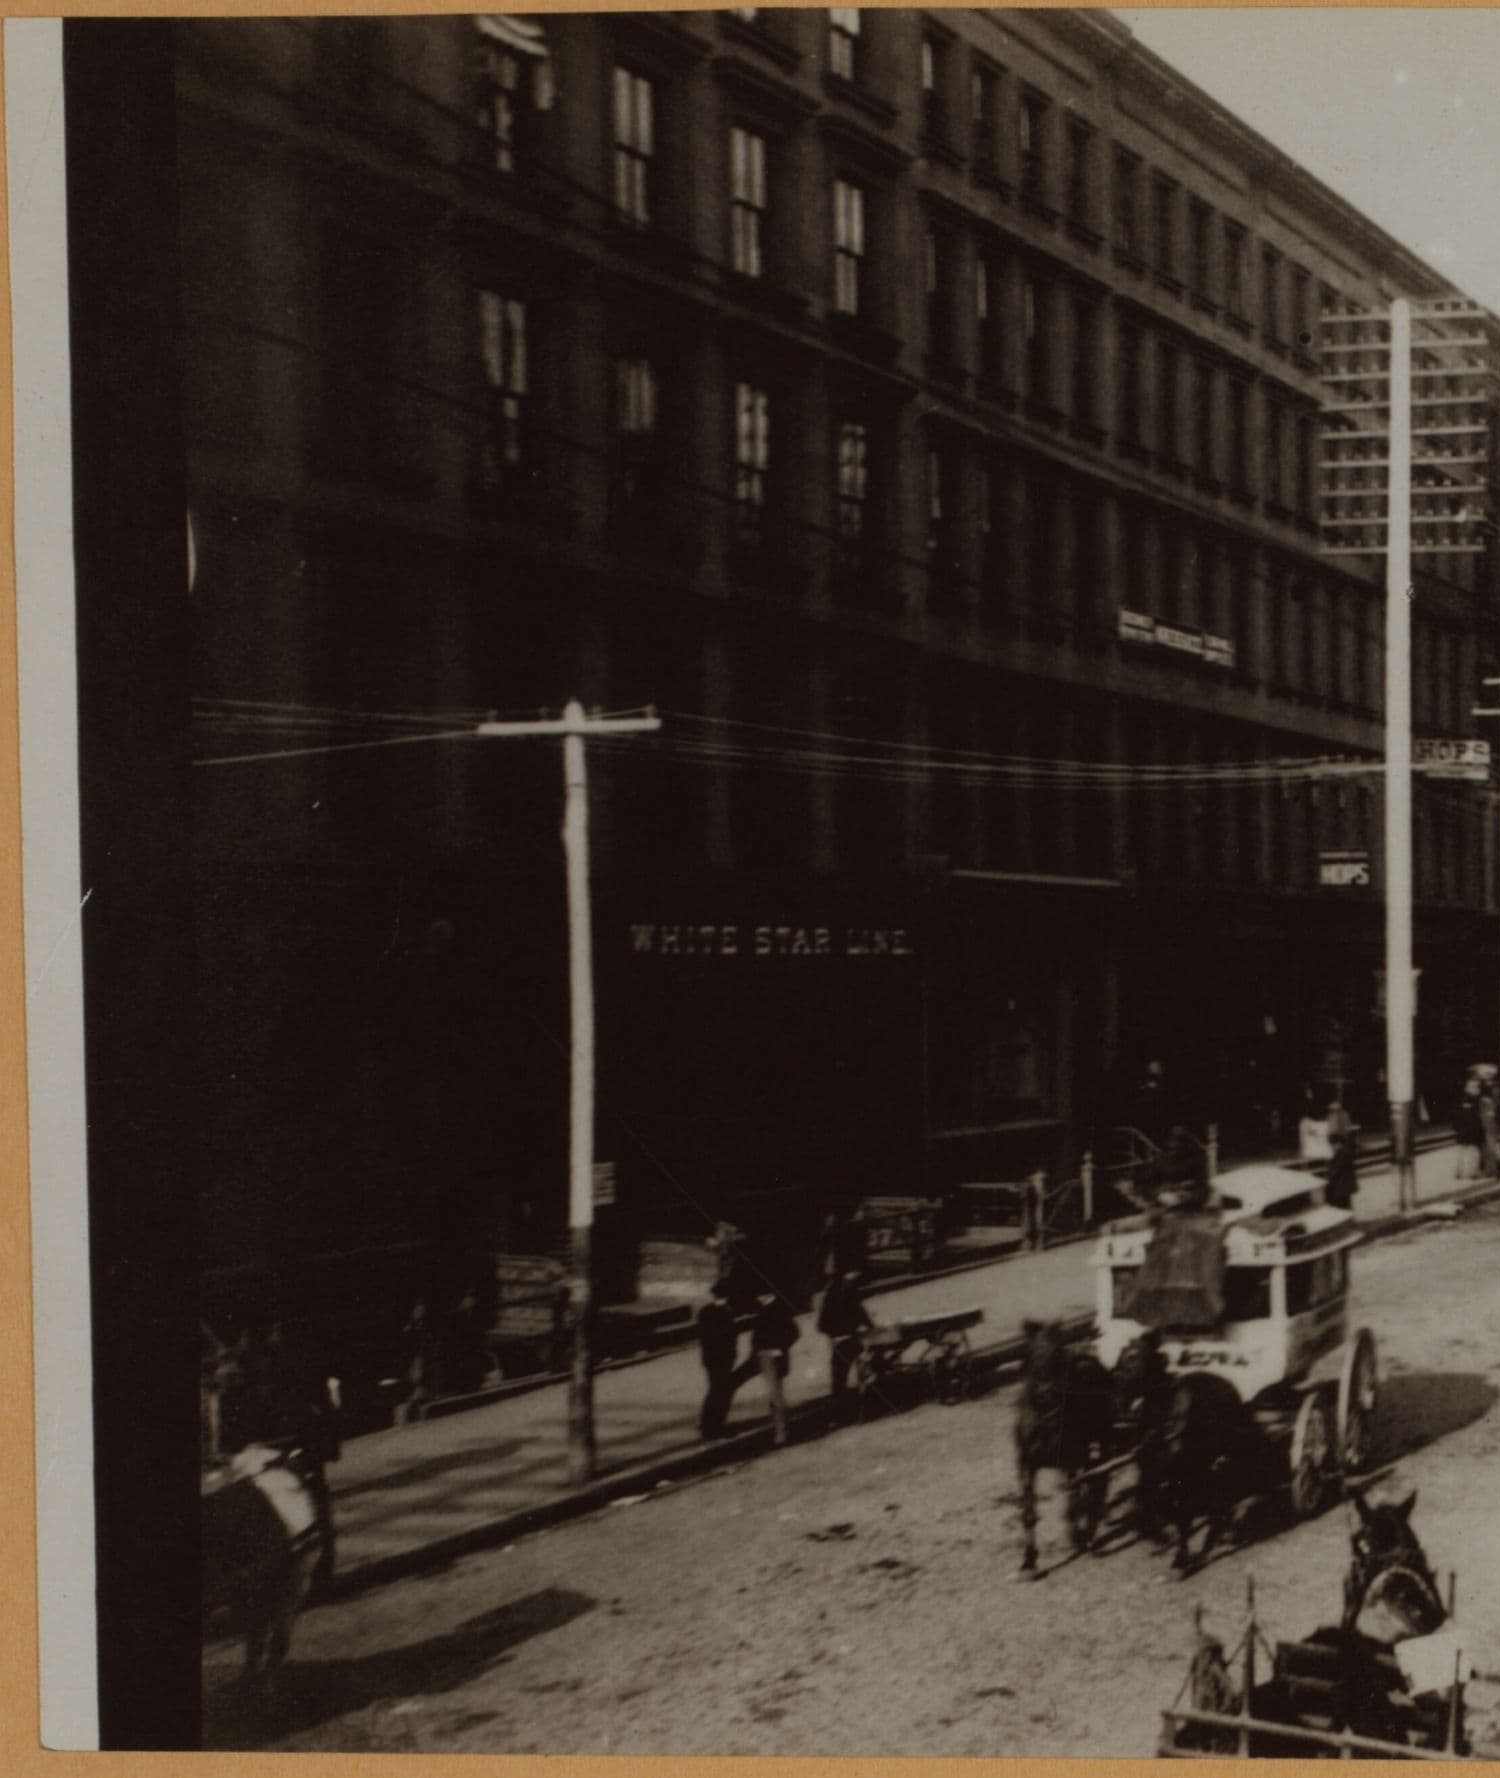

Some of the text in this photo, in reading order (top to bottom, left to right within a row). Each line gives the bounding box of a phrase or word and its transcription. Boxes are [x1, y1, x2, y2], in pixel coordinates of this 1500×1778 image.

[1416, 741, 1486, 761] HOPS
[1319, 863, 1369, 885] HOPS
[630, 925, 915, 954] WHITE STAR LINE
